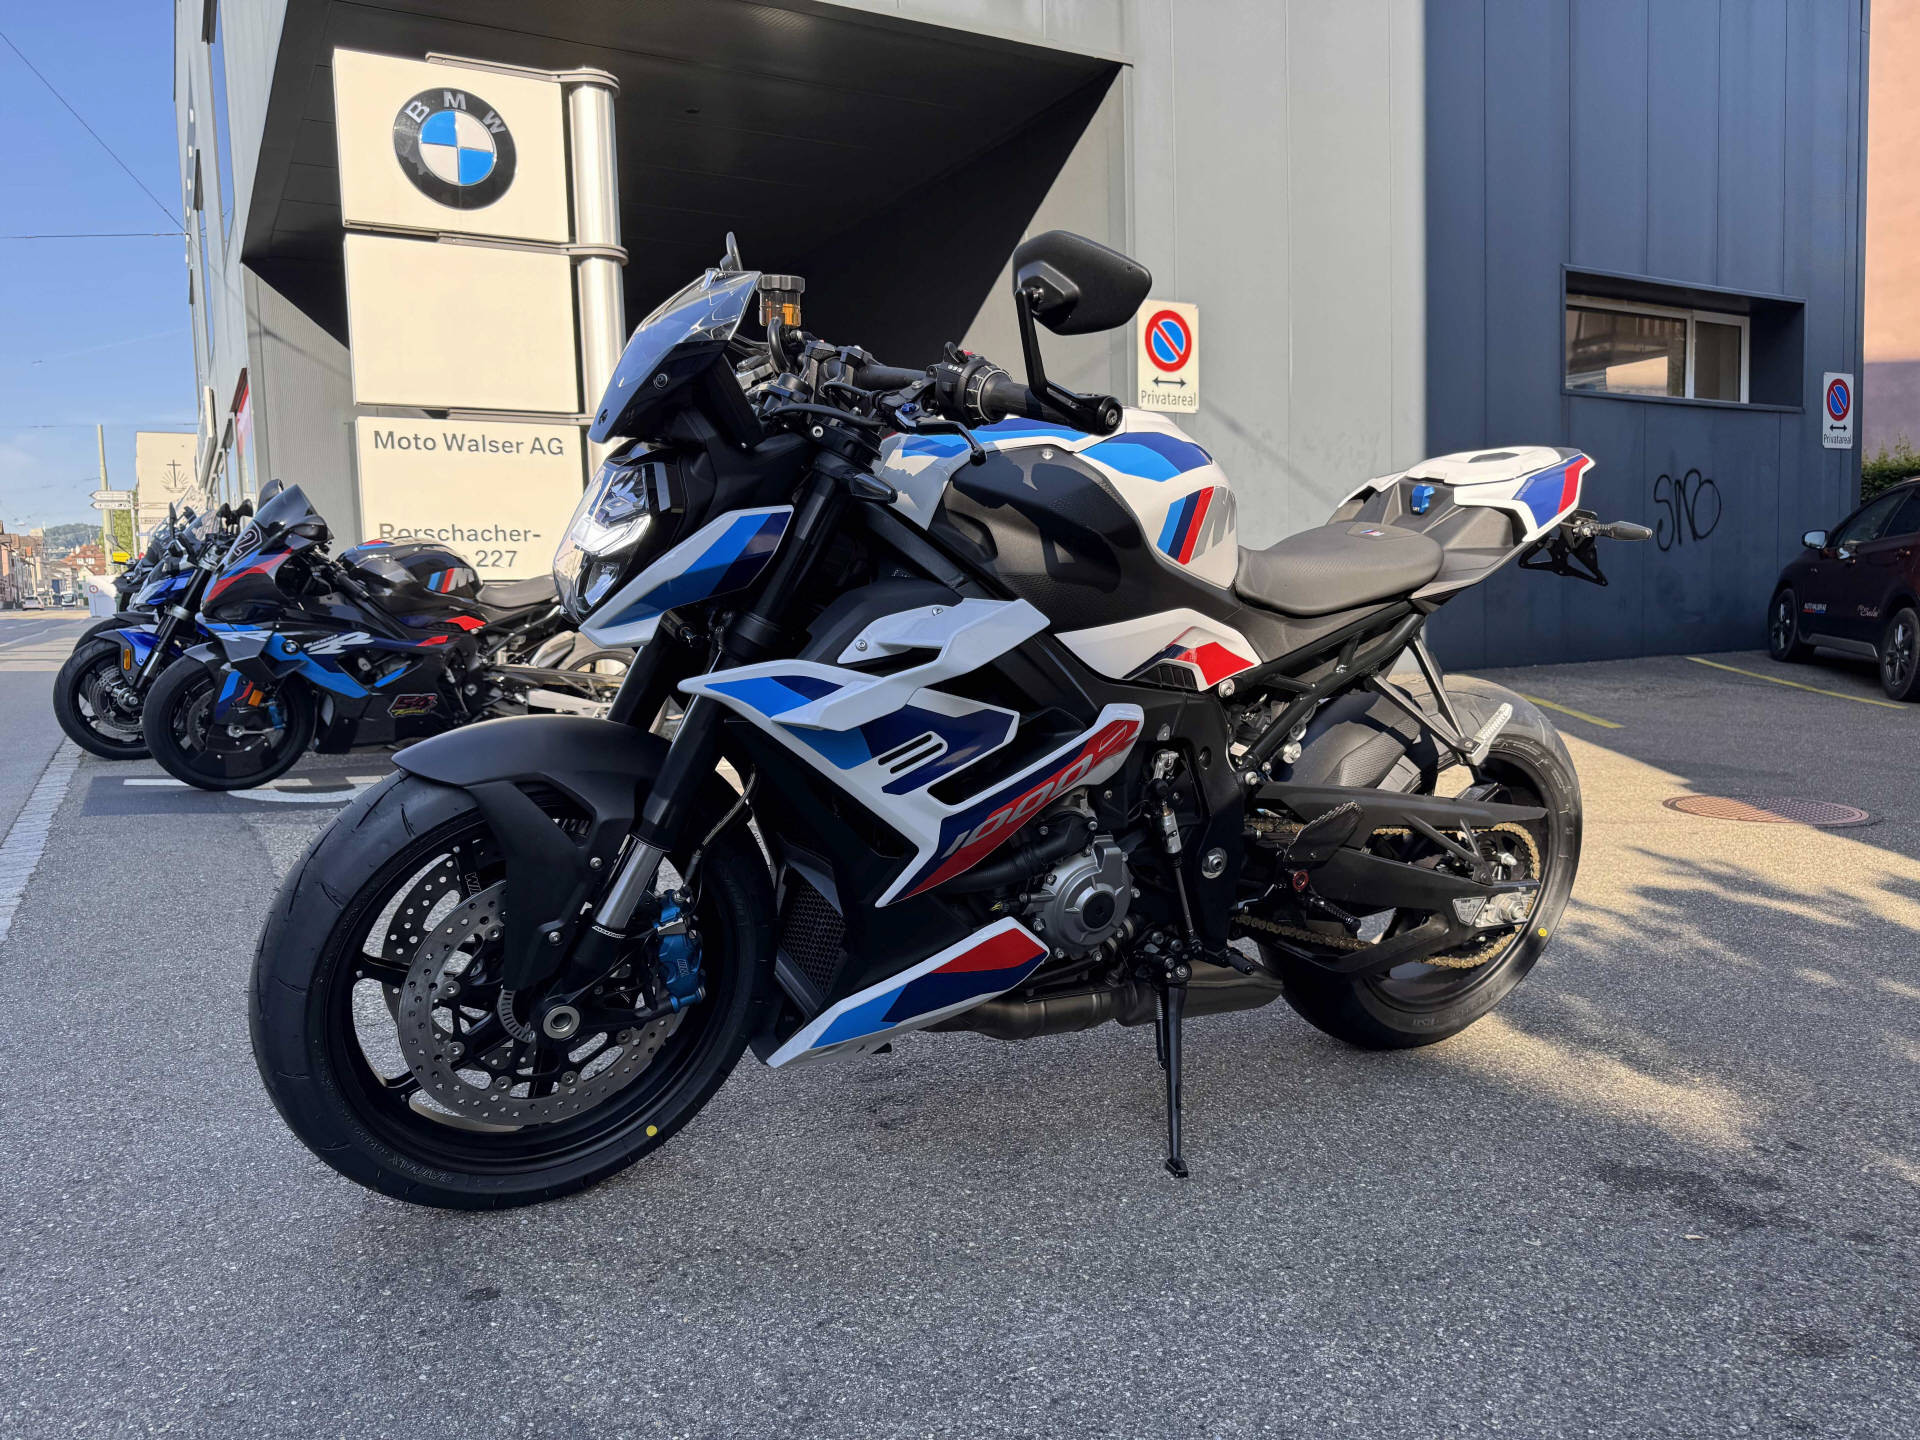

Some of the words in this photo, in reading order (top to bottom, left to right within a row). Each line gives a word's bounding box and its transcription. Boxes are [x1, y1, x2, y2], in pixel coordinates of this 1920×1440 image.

[404, 90, 507, 134] BMW
[1141, 390, 1197, 407] Privatareal
[373, 430, 437, 451] Moto
[443, 432, 524, 454] Walser
[529, 437, 564, 456] AG
[1824, 433, 1852, 445] Privatareal
[475, 550, 518, 569] 227
